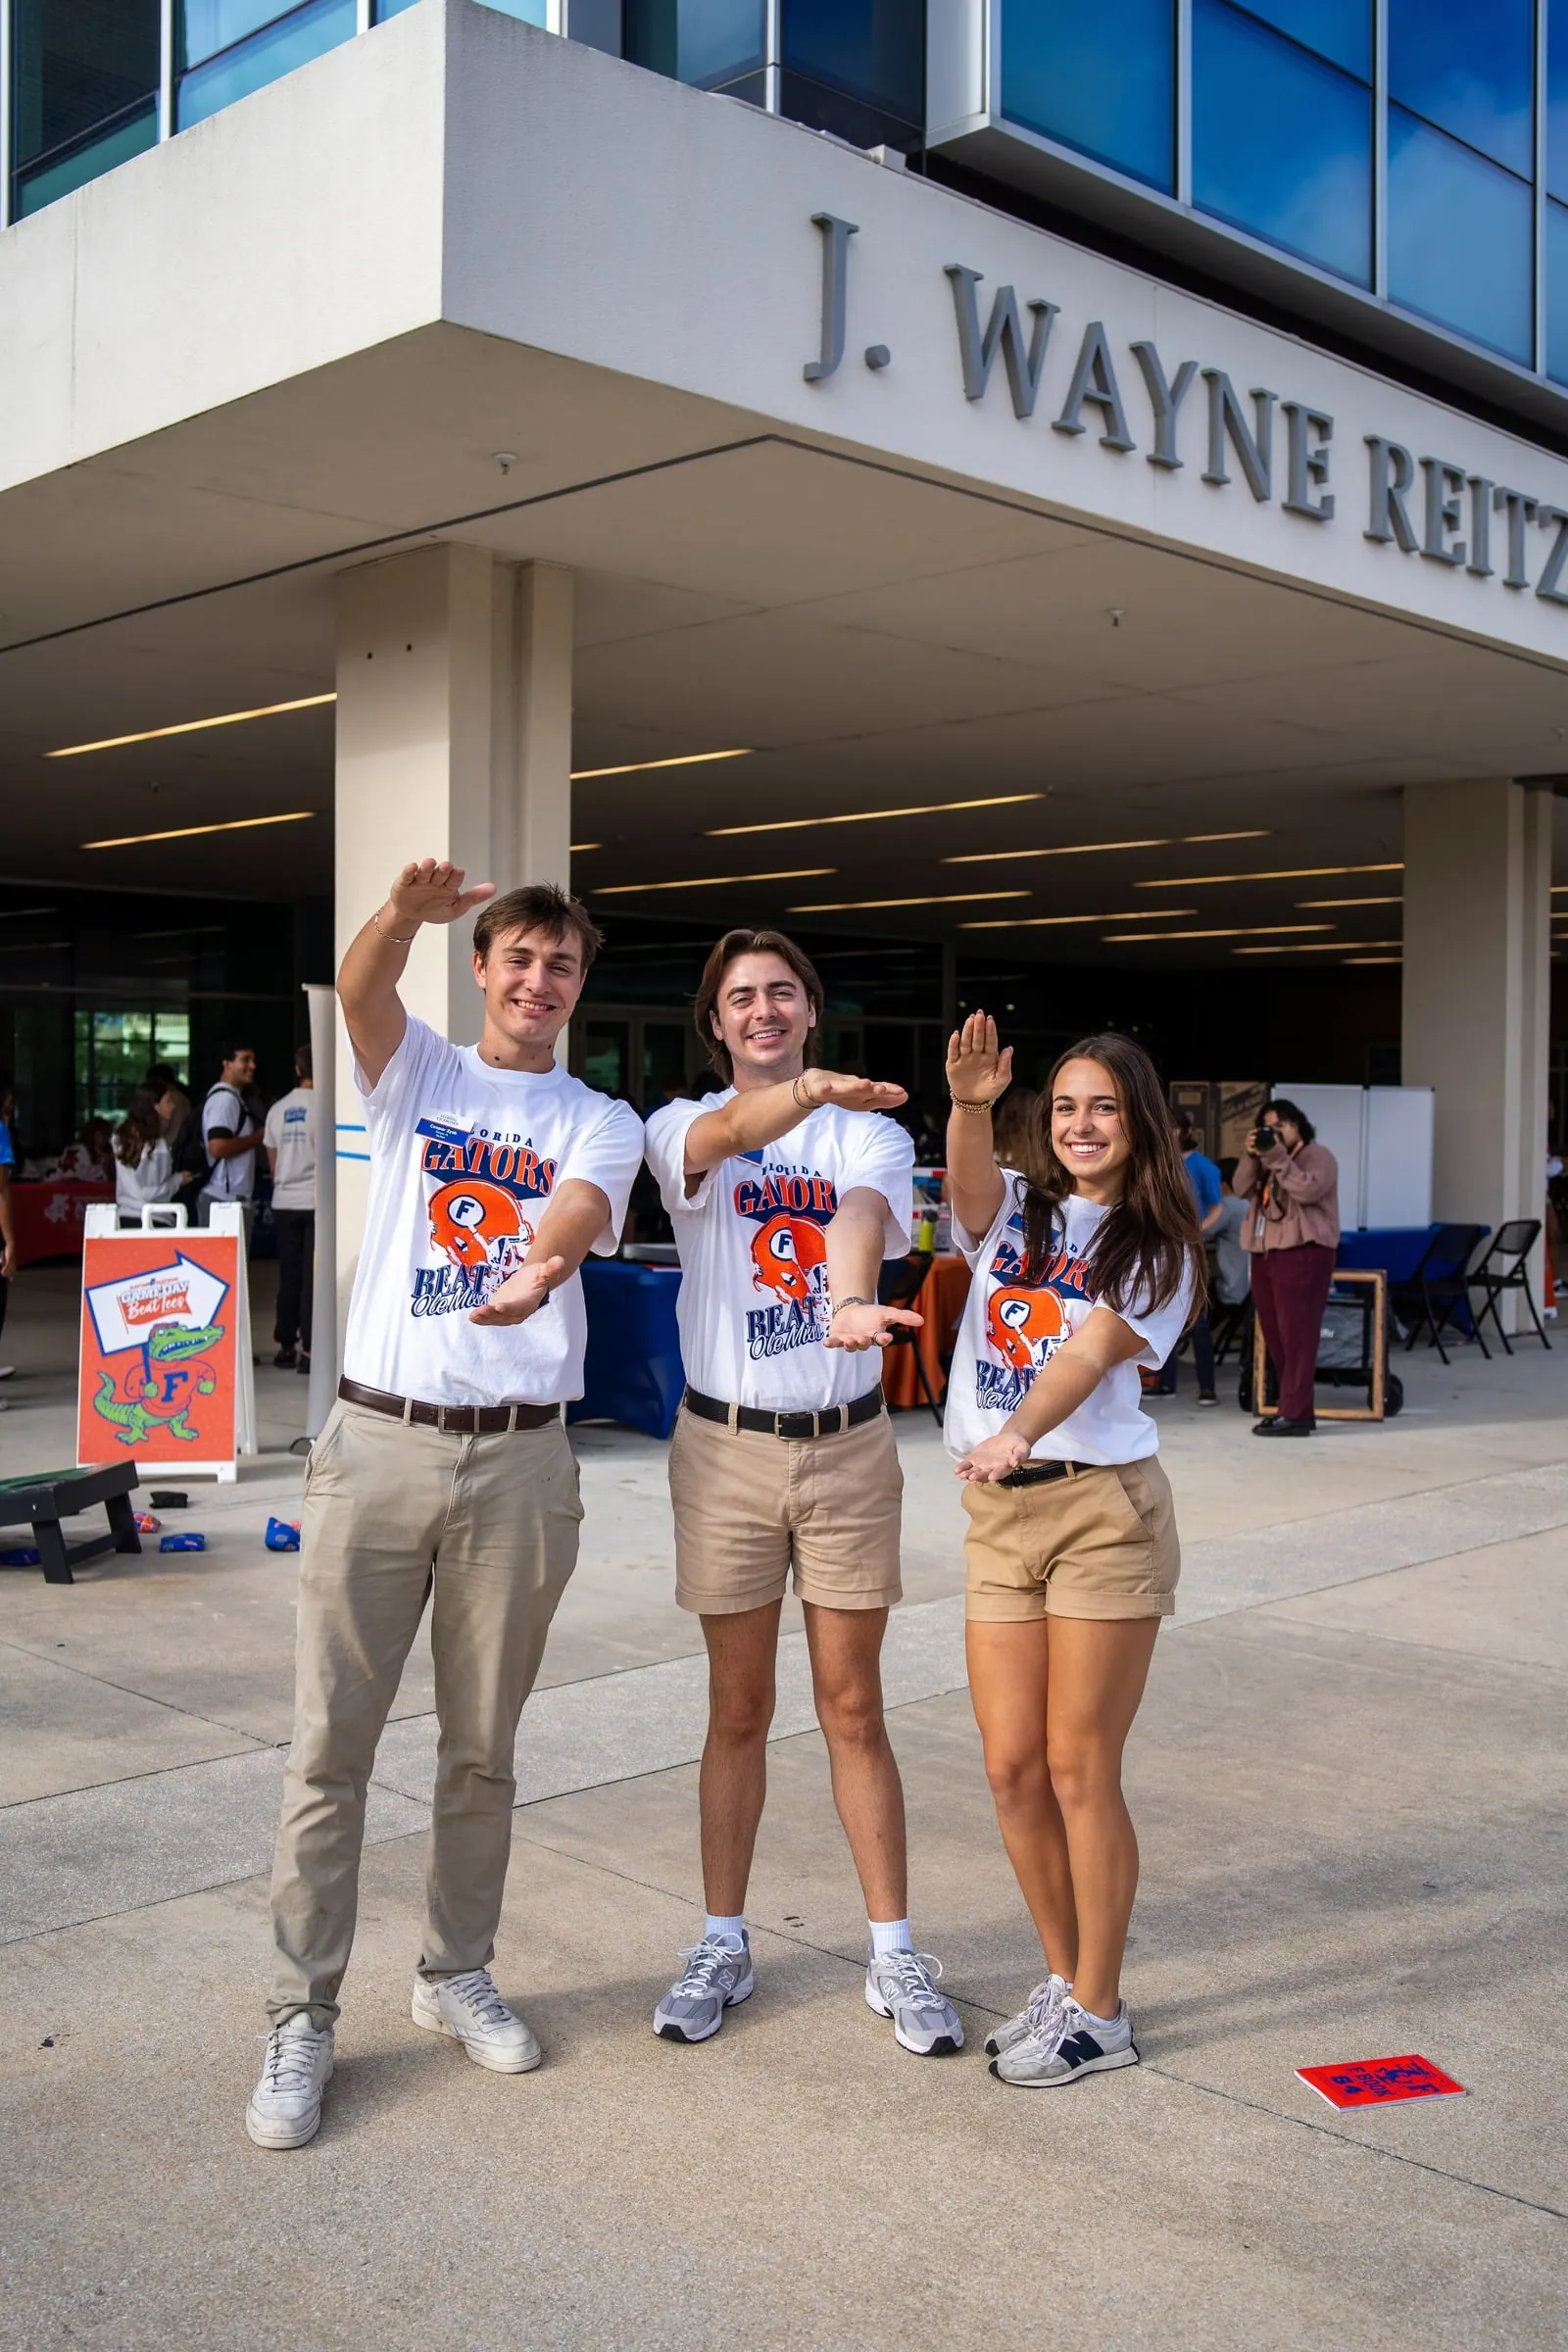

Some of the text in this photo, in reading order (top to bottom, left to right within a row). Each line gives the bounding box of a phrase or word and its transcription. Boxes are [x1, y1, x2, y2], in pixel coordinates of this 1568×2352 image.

[804, 212, 1568, 606] J. WAYNE REITZ
[420, 1137, 558, 1197] GATORS
[456, 1200, 475, 1219] F
[733, 1175, 837, 1216] GATOR
[778, 1234, 792, 1253] F
[121, 1280, 189, 1304] GAMEDAY
[412, 1264, 493, 1298] BEAT
[126, 1297, 161, 1320] Beat
[412, 1293, 449, 1317] Ole
[1004, 1302, 1025, 1320] F
[746, 1296, 816, 1343] BEAT
[750, 1331, 785, 1361] Ole
[784, 1321, 824, 1351] Miss
[162, 1371, 189, 1403] F
[975, 1359, 1037, 1396] BEAT
[718, 1968, 735, 1991] N
[883, 1979, 901, 2001] N
